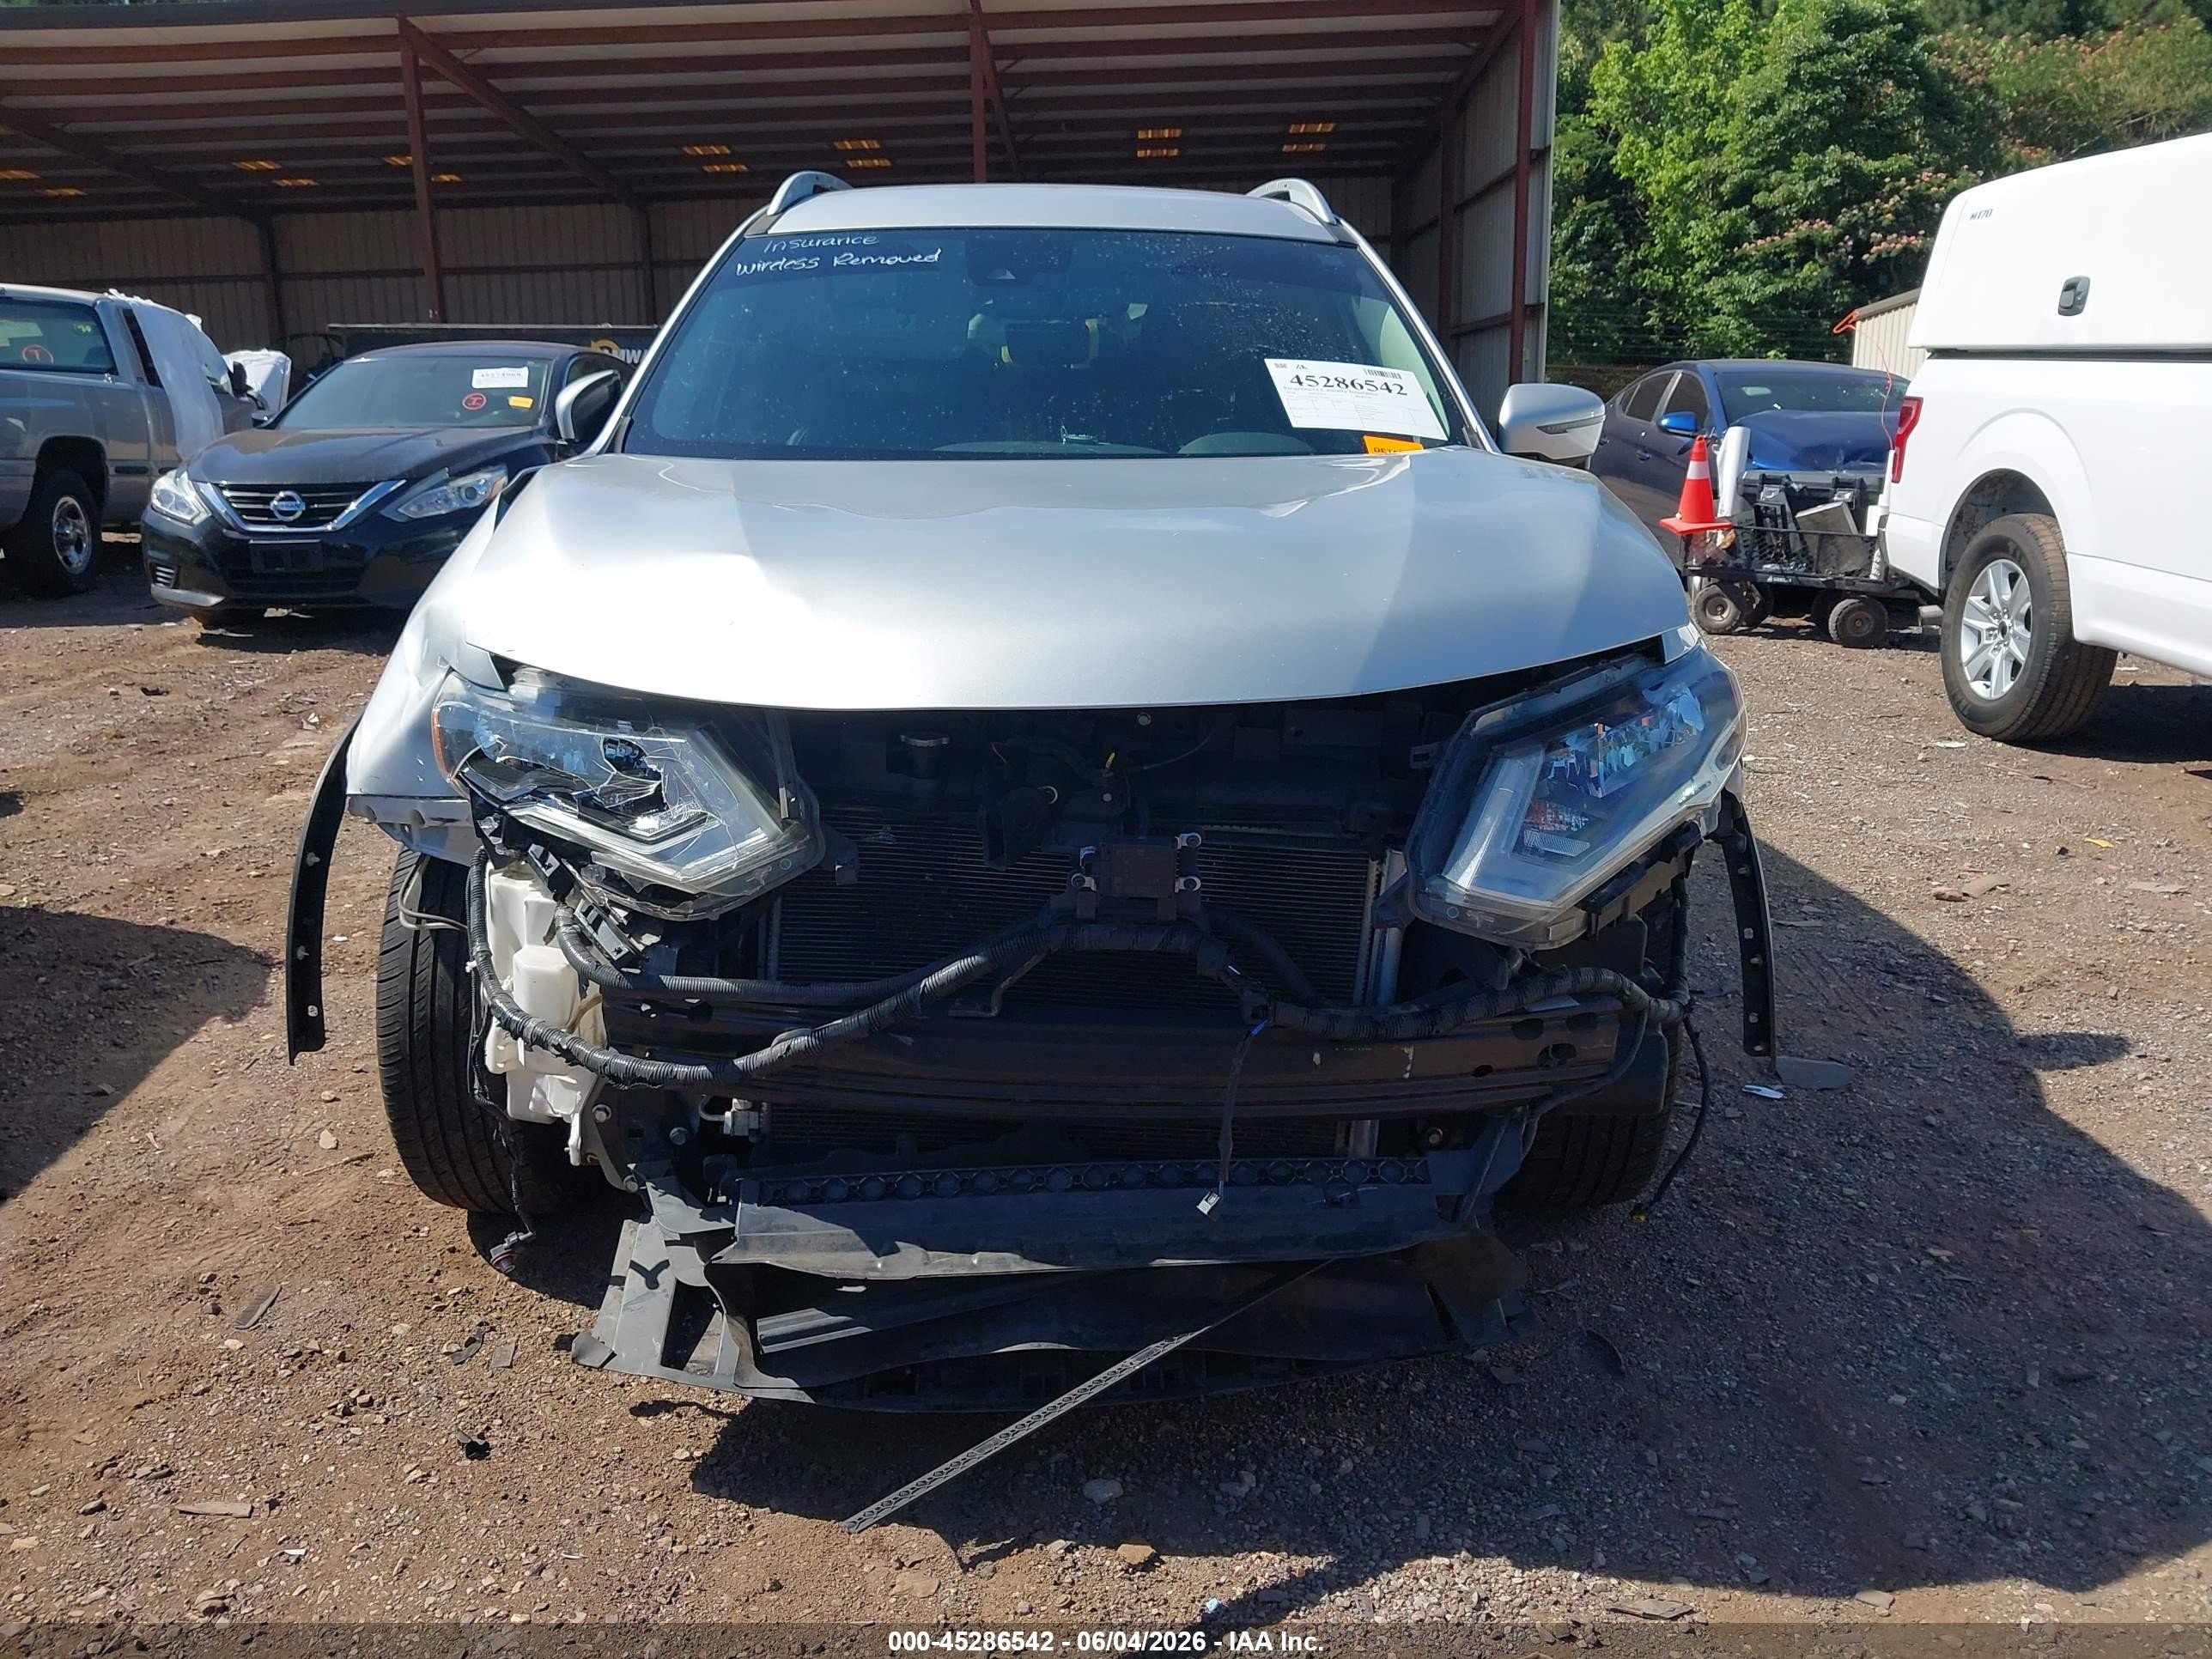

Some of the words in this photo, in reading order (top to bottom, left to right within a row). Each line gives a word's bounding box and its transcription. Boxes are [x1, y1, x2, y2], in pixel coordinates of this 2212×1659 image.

[763, 234, 880, 253] Insurance
[833, 247, 943, 267] Removed
[1290, 374, 1408, 396] 45286542
